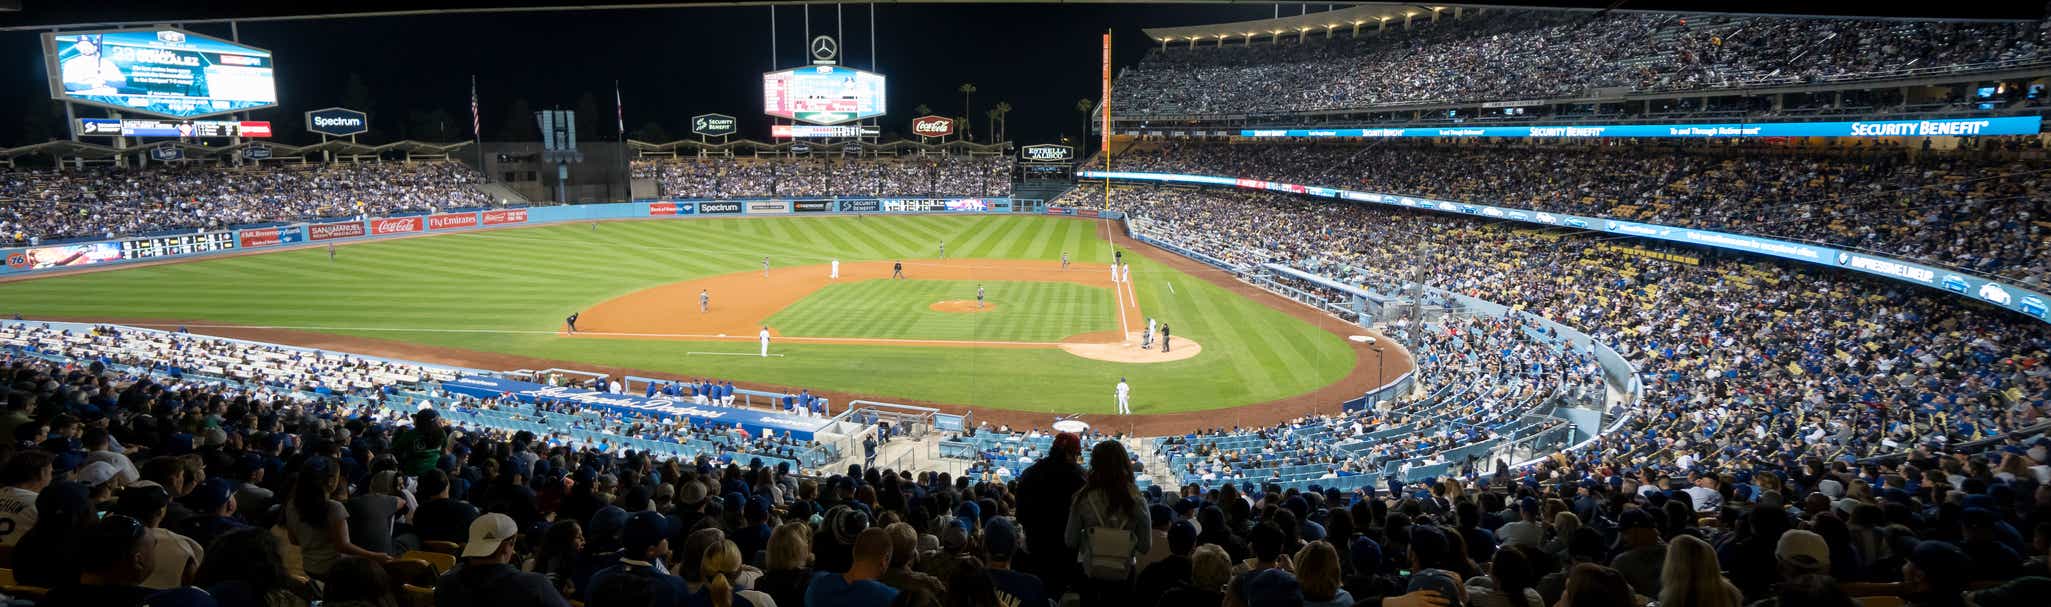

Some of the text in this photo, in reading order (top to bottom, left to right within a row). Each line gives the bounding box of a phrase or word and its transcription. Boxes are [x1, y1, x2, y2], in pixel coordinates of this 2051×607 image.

[314, 116, 360, 128] Spectrum
[916, 120, 949, 133] Coca-Cola
[1529, 127, 1566, 137] SECURITY
[1851, 121, 1918, 136] SECURITY
[1032, 152, 1063, 160] JALISCO
[701, 204, 738, 213] Spectrum
[379, 218, 415, 233] Coca-Cola
[430, 217, 443, 227] Fly
[444, 214, 476, 226] Emirates
[11, 255, 24, 265] 76
[641, 399, 727, 418] Dodgers
